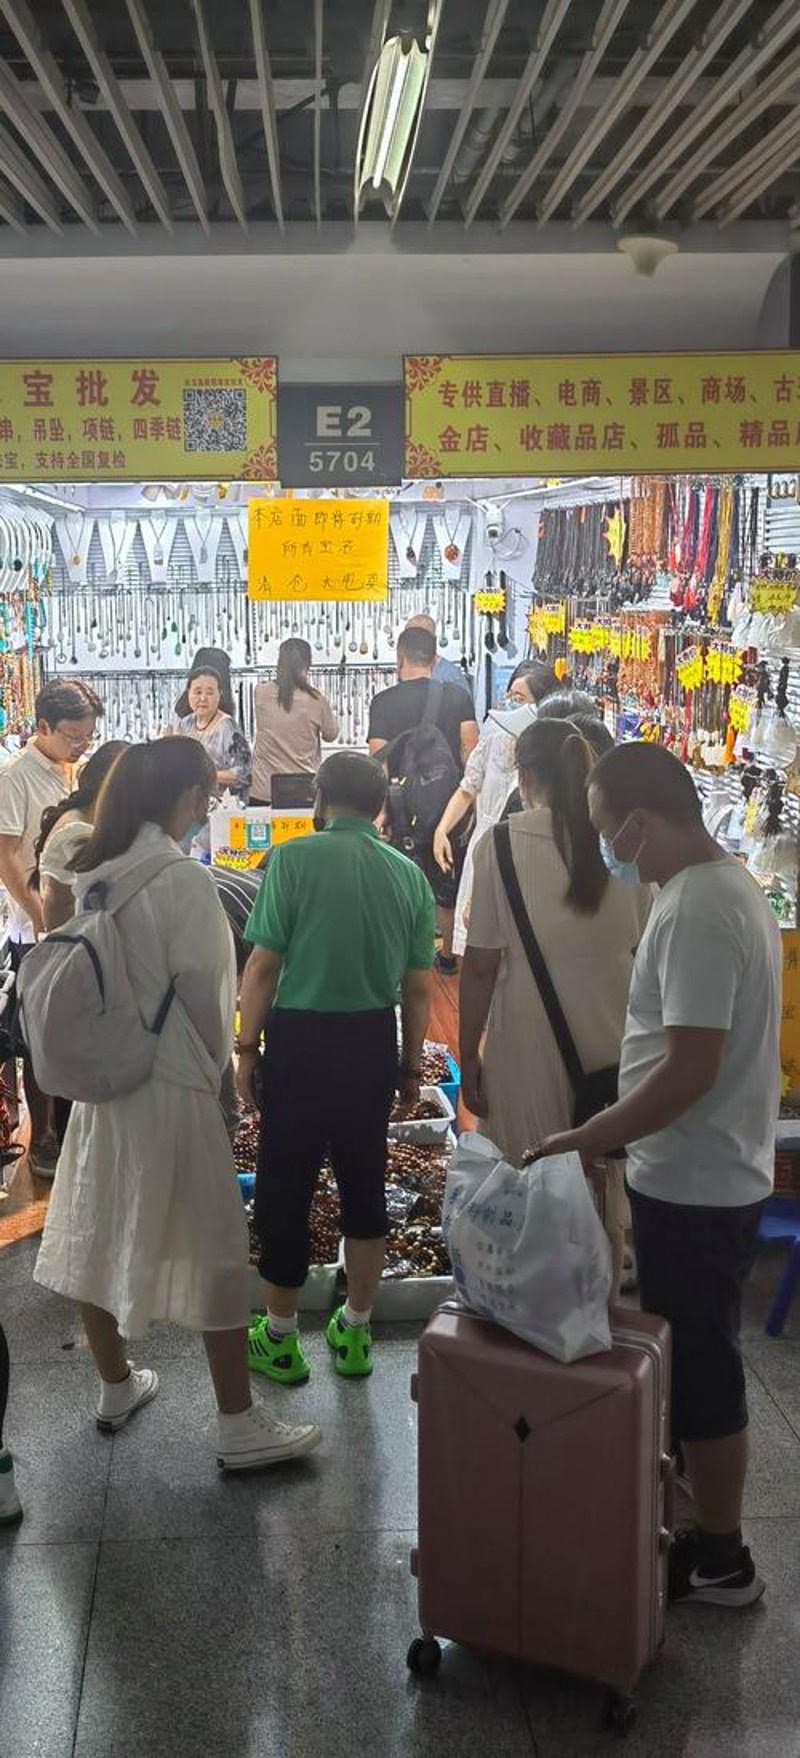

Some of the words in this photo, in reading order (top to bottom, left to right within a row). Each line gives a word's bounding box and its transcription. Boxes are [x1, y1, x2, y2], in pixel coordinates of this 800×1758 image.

[23, 369, 161, 407] 宝批发
[438, 374, 800, 408] 专供直播、电商、景区、商场、古
[316, 406, 372, 436] E2
[438, 420, 800, 453] 金店、收藏品店、孤品、精品
[0, 450, 126, 469] 宝，支持全国复检
[309, 450, 375, 472] 5704
